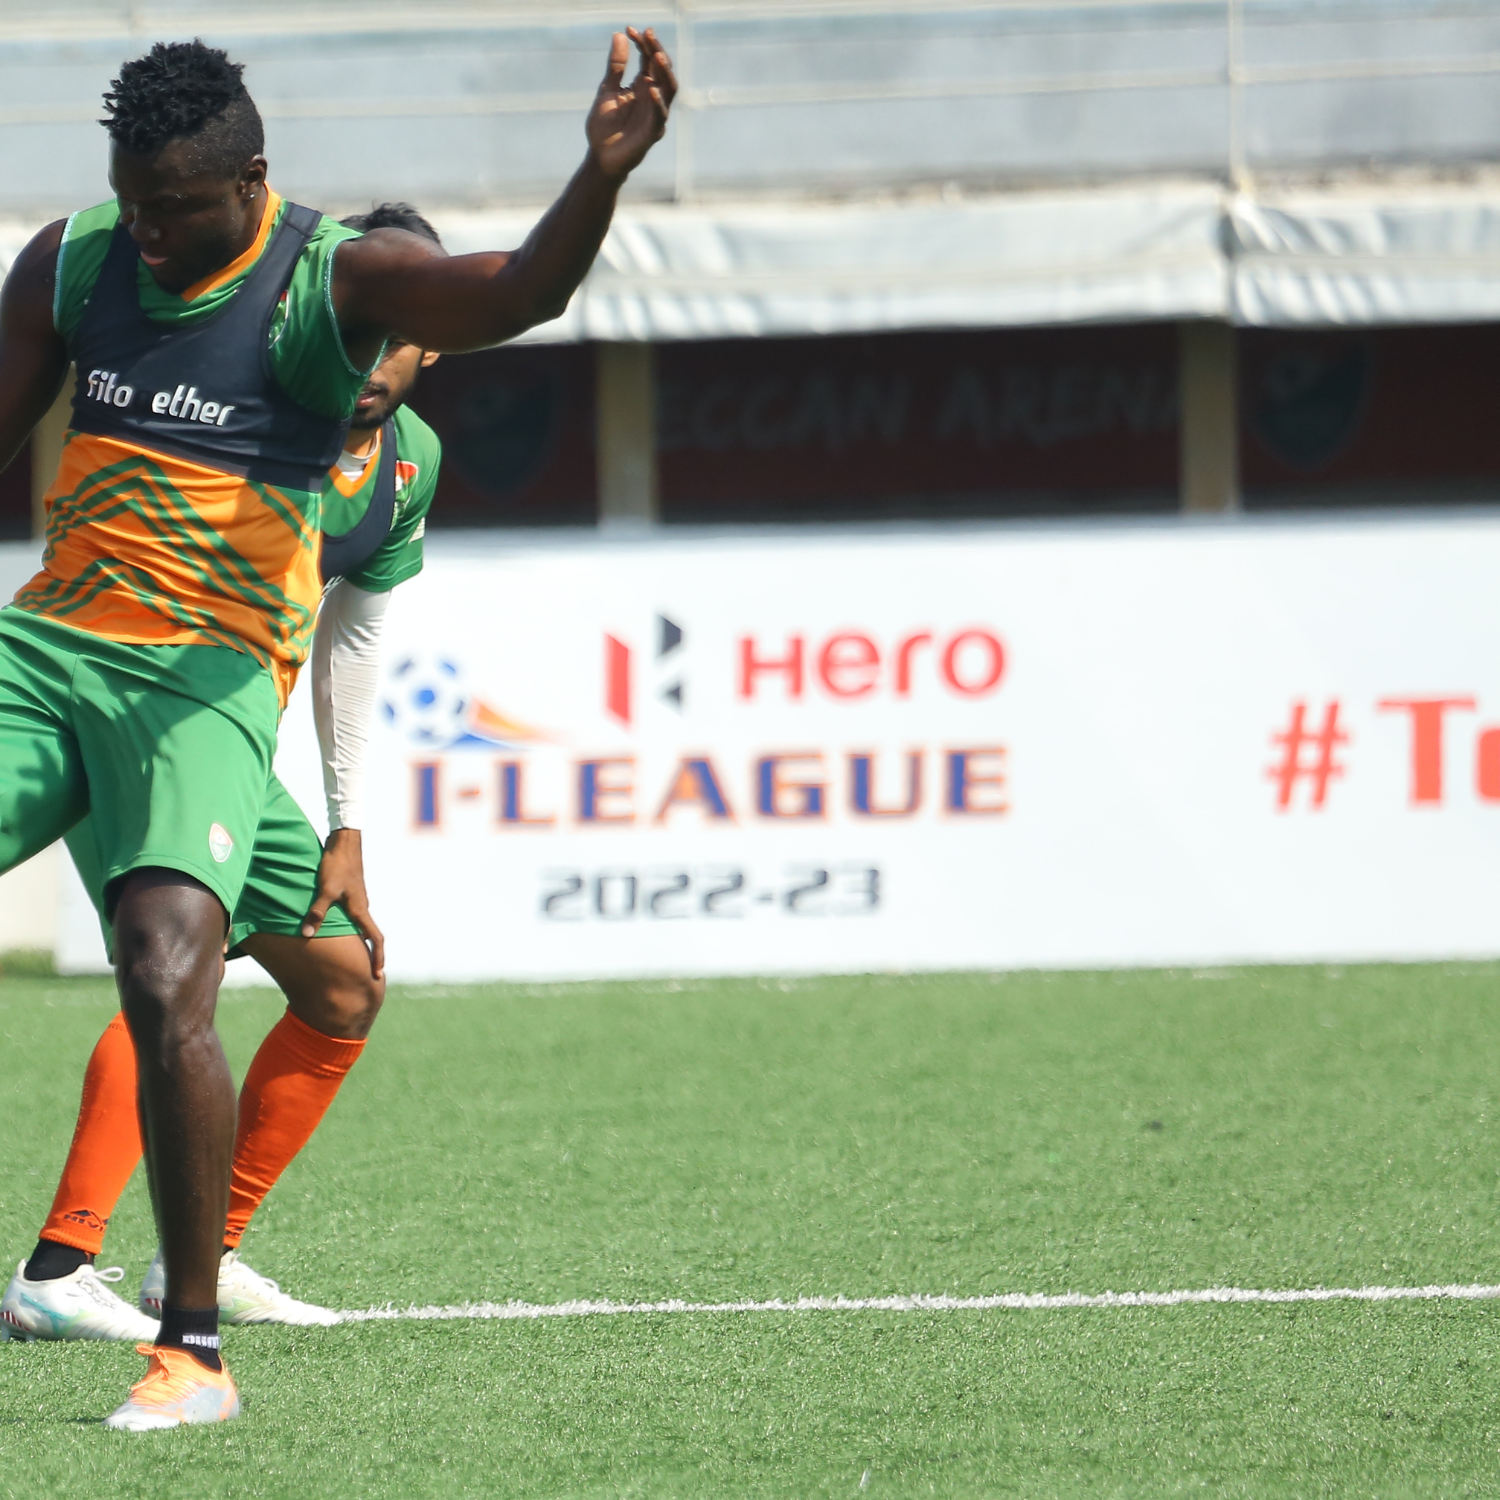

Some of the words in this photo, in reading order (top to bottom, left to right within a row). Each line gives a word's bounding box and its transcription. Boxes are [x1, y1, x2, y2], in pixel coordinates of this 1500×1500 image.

[656, 370, 912, 452] ECCAN
[734, 630, 1009, 702] Hero
[411, 744, 1009, 833] I-LEAGUE
[538, 864, 882, 922] 2022-23
